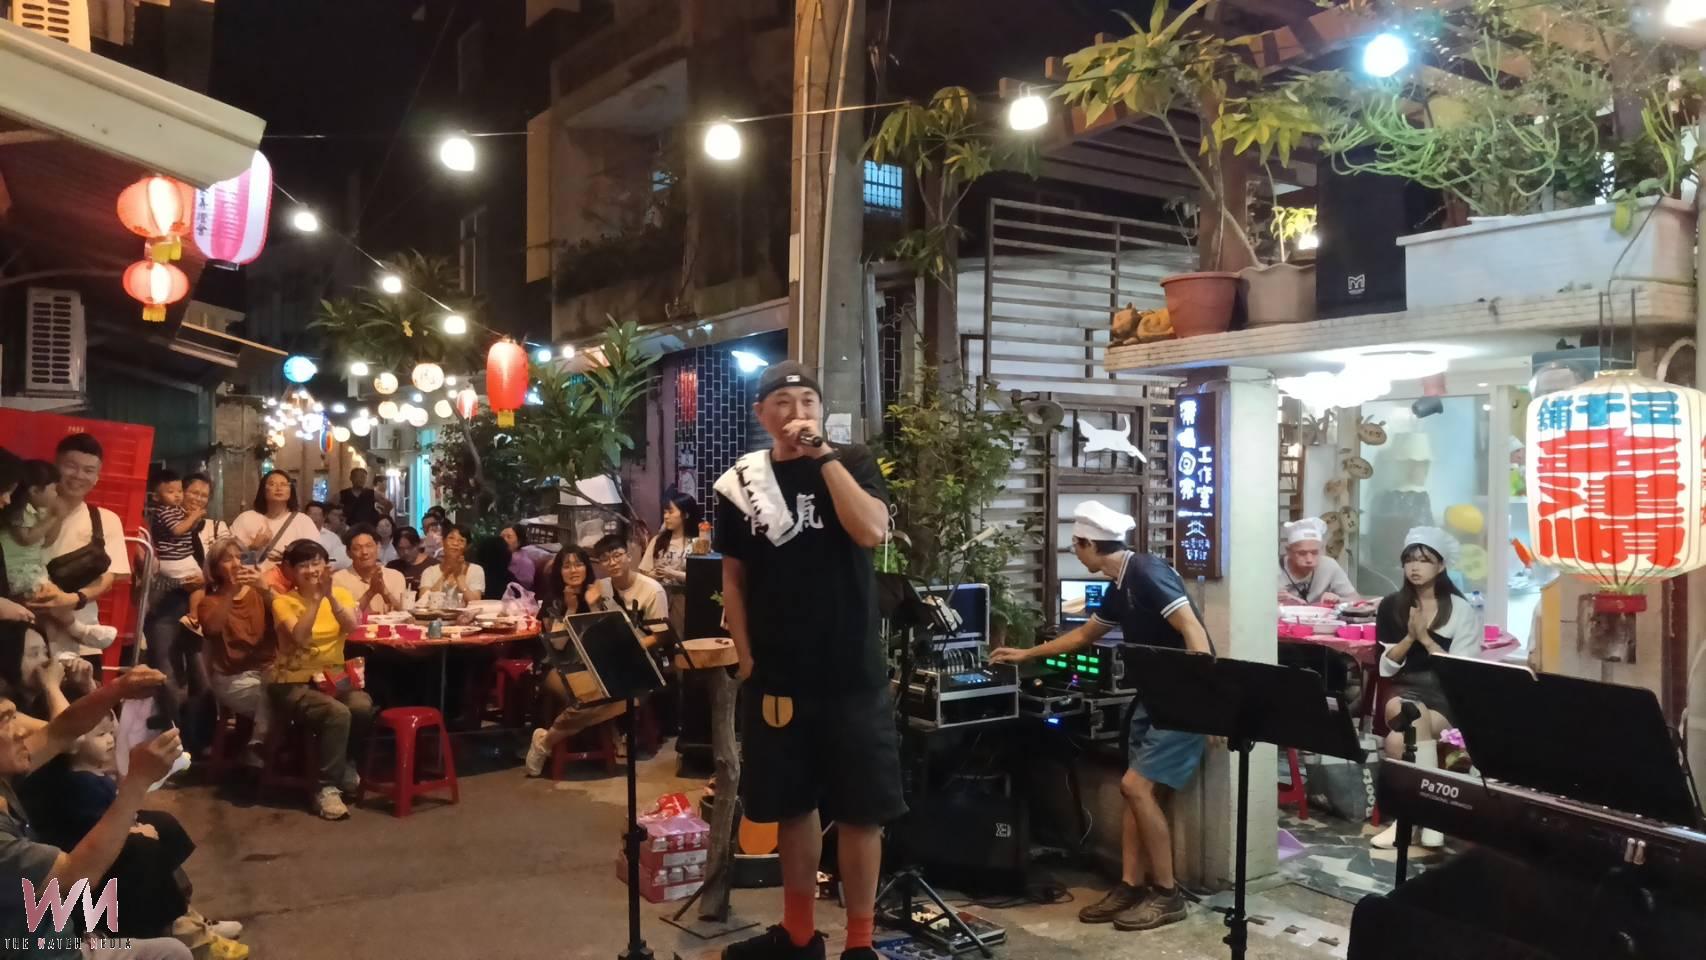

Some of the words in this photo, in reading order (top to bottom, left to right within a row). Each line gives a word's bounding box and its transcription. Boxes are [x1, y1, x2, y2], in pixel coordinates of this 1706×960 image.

[1196, 446, 1213, 508] 工作室
[1420, 778, 1459, 799] Pa700
